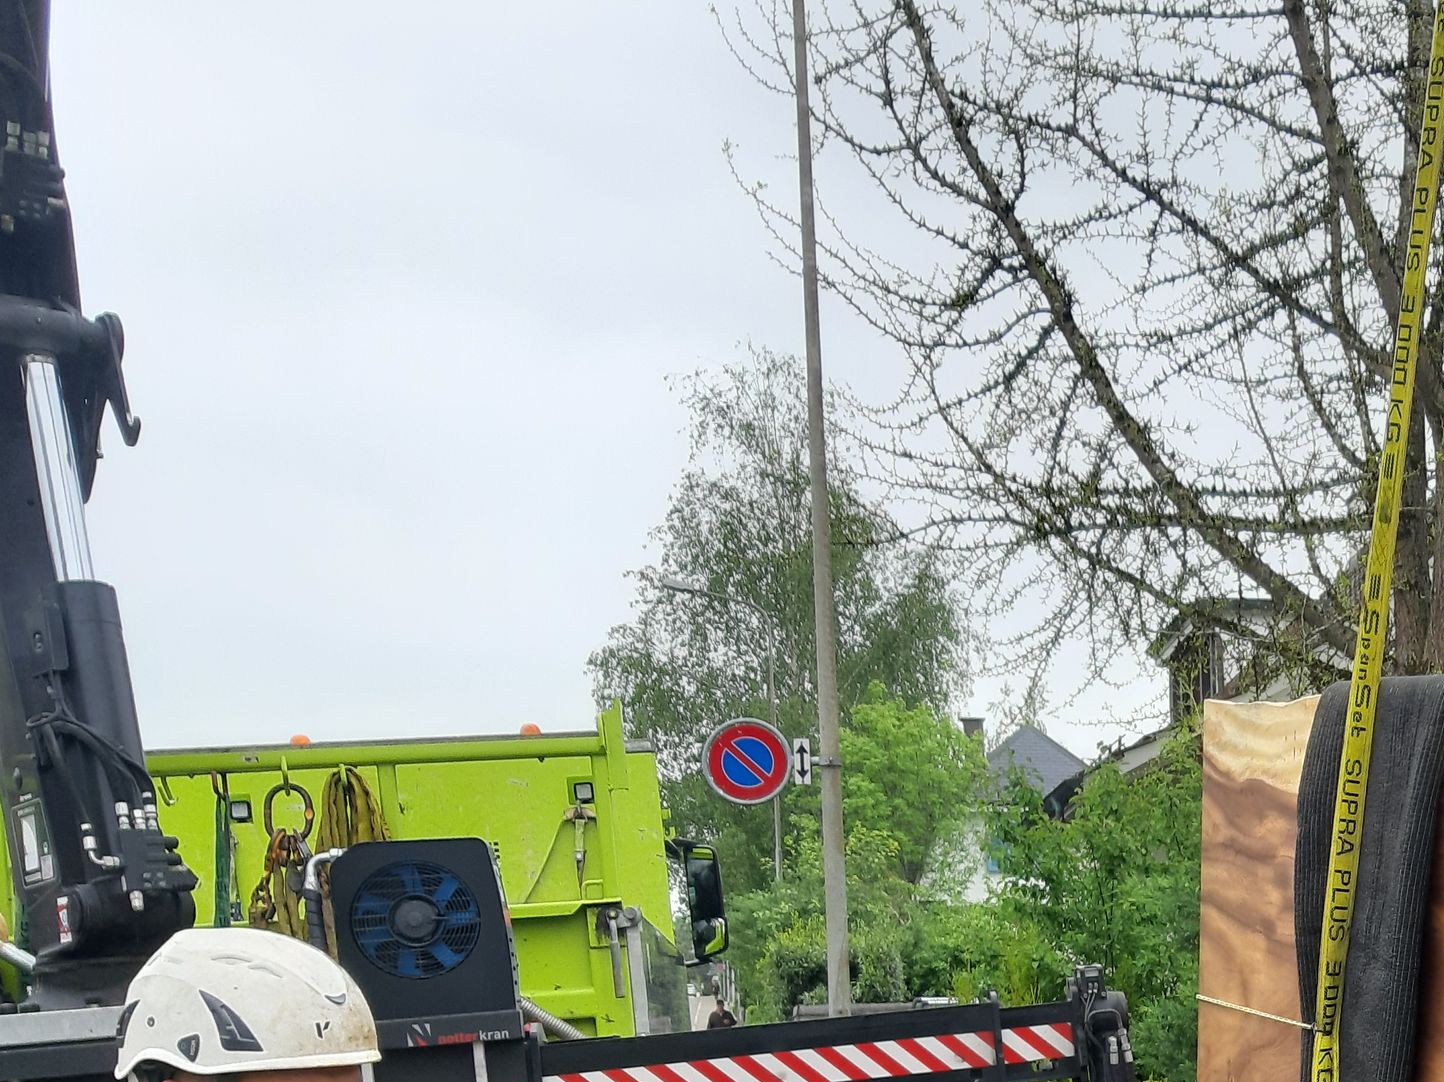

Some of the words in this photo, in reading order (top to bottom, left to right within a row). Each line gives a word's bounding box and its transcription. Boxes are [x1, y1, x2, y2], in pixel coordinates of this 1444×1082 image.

[1406, 187, 1429, 272] PLUS
[1392, 295, 1416, 385] 3000
[1386, 399, 1404, 443] KG
[1350, 609, 1380, 738] SpanSet
[1336, 758, 1362, 856] SUPRA
[1328, 869, 1352, 942] PLUS
[437, 1029, 510, 1045] notterkran
[1322, 960, 1342, 1037] 3000
